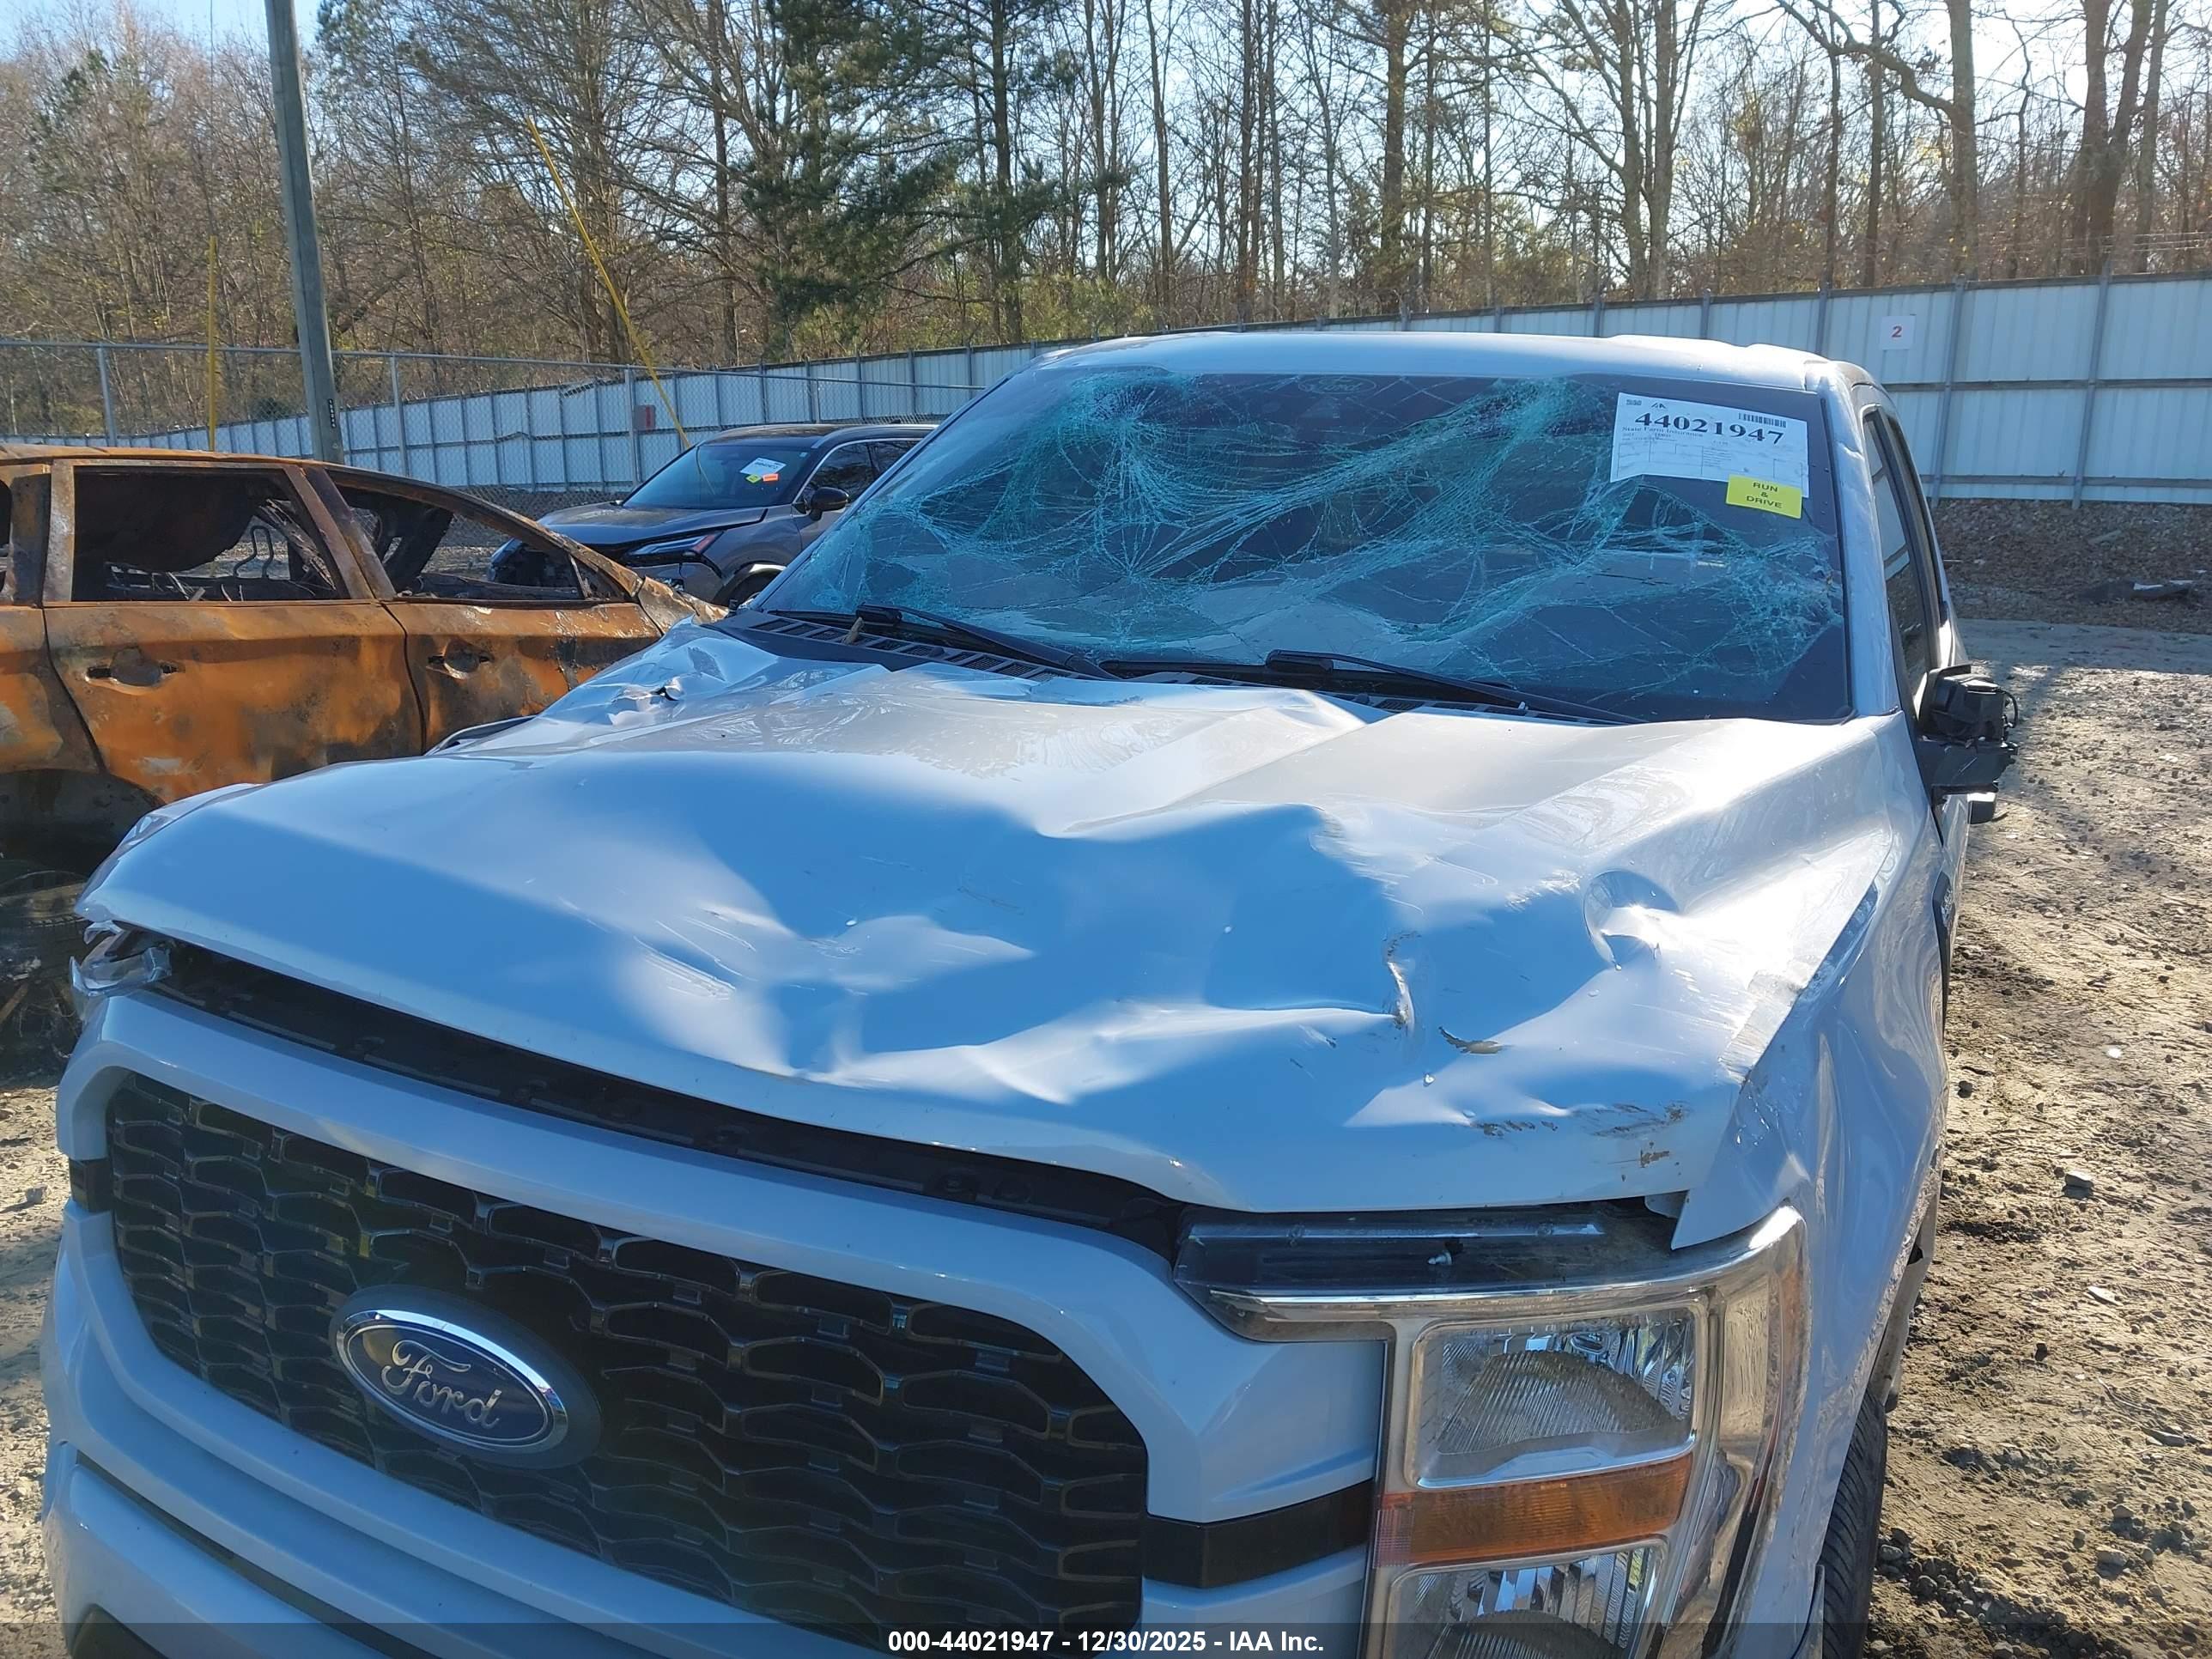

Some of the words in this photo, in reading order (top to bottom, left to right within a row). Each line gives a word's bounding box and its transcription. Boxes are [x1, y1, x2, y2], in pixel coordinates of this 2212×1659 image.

[1891, 325, 1903, 337] 2
[1635, 412, 1785, 445] 44021947
[1753, 482, 1778, 492] RUN
[1746, 495, 1784, 508] DRIVE
[380, 1340, 502, 1430] Ford
